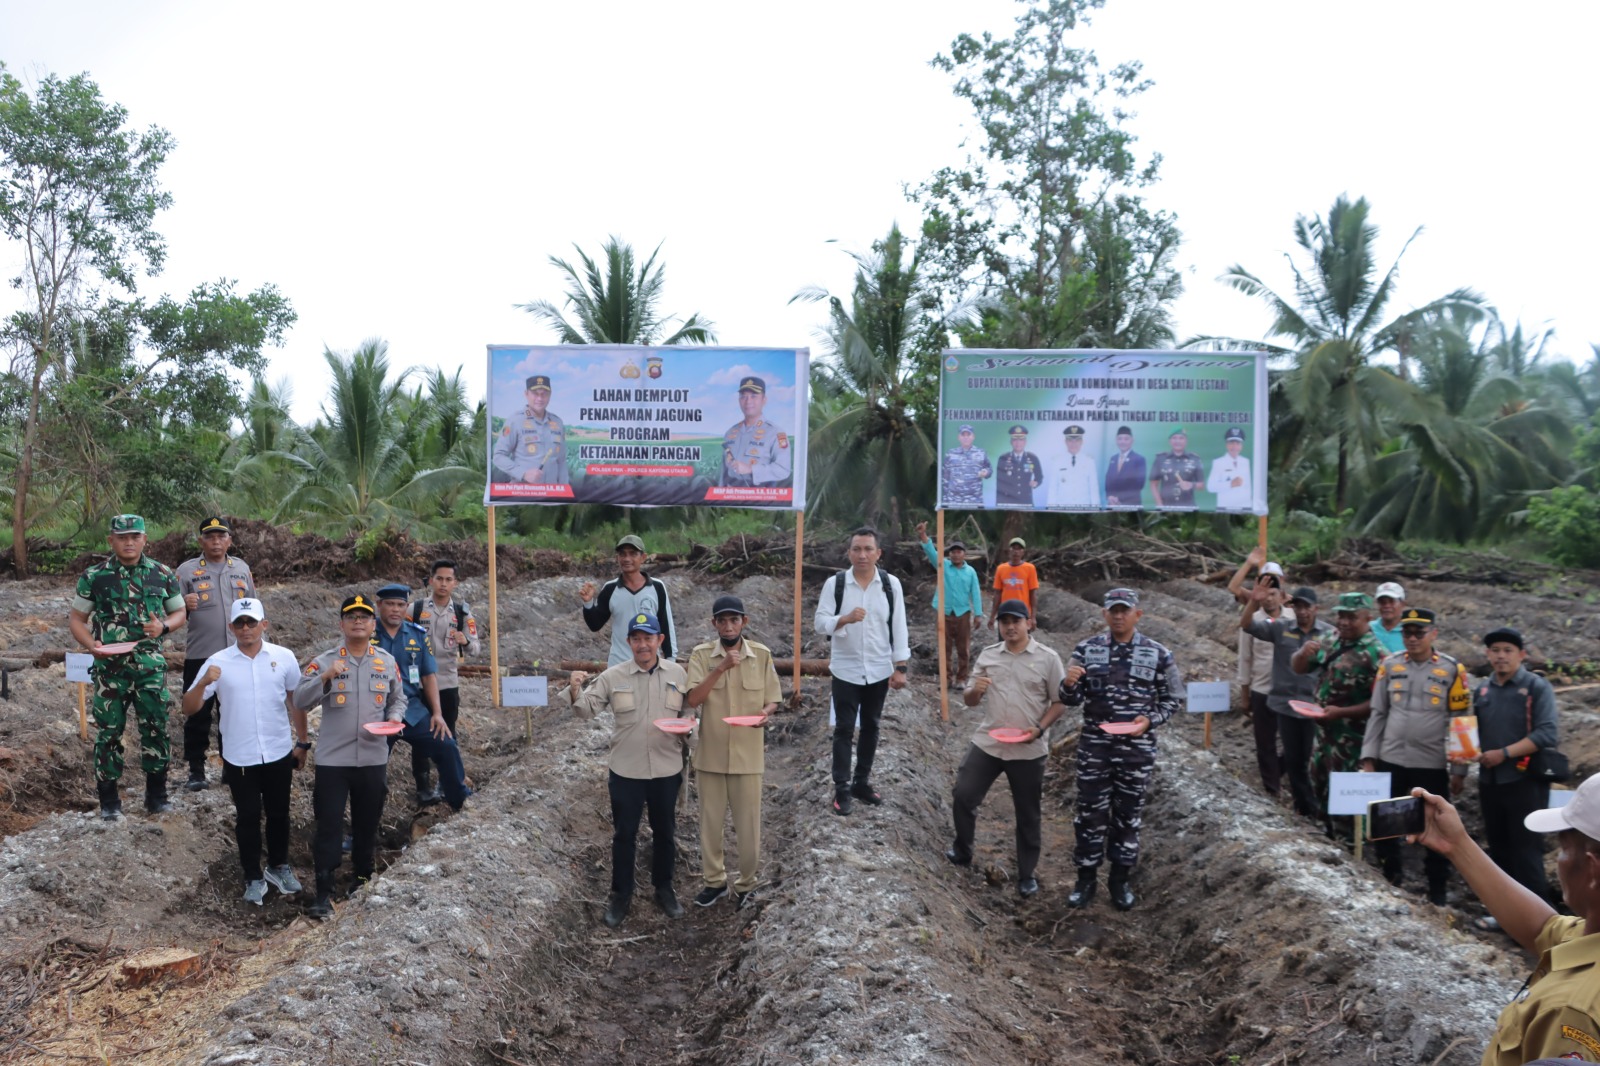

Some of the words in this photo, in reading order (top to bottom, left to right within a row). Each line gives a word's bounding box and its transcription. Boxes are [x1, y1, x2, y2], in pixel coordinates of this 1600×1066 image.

[966, 355, 1116, 371] Selamat
[1109, 360, 1251, 372] Datang
[968, 378, 997, 389] BUPATI
[1000, 378, 1032, 389] KAYONG
[1034, 378, 1060, 389] UTARA
[1062, 378, 1080, 389] DAN
[1136, 378, 1146, 390] DI
[1148, 379, 1169, 390] DESA
[1171, 379, 1194, 390] SATAI
[1196, 379, 1230, 390] LESTARI
[593, 389, 631, 402] LAHAN
[634, 390, 689, 402] DEMPLOT
[1066, 394, 1094, 408] Dalam
[1096, 394, 1130, 408] Rangka
[580, 408, 652, 421] PENANAMAN
[656, 408, 702, 422] JAGUNG
[944, 410, 992, 420] PENANAMAN
[996, 410, 1034, 420] KEGIATAN
[1037, 410, 1084, 421] KETAHANAN
[1086, 410, 1120, 421] PANGAN
[1122, 411, 1156, 422] TINGKAT
[1159, 412, 1180, 422] DESA
[610, 427, 670, 440] PROGRAM
[580, 446, 648, 460] KETAHANAN
[652, 446, 700, 460] PANGAN
